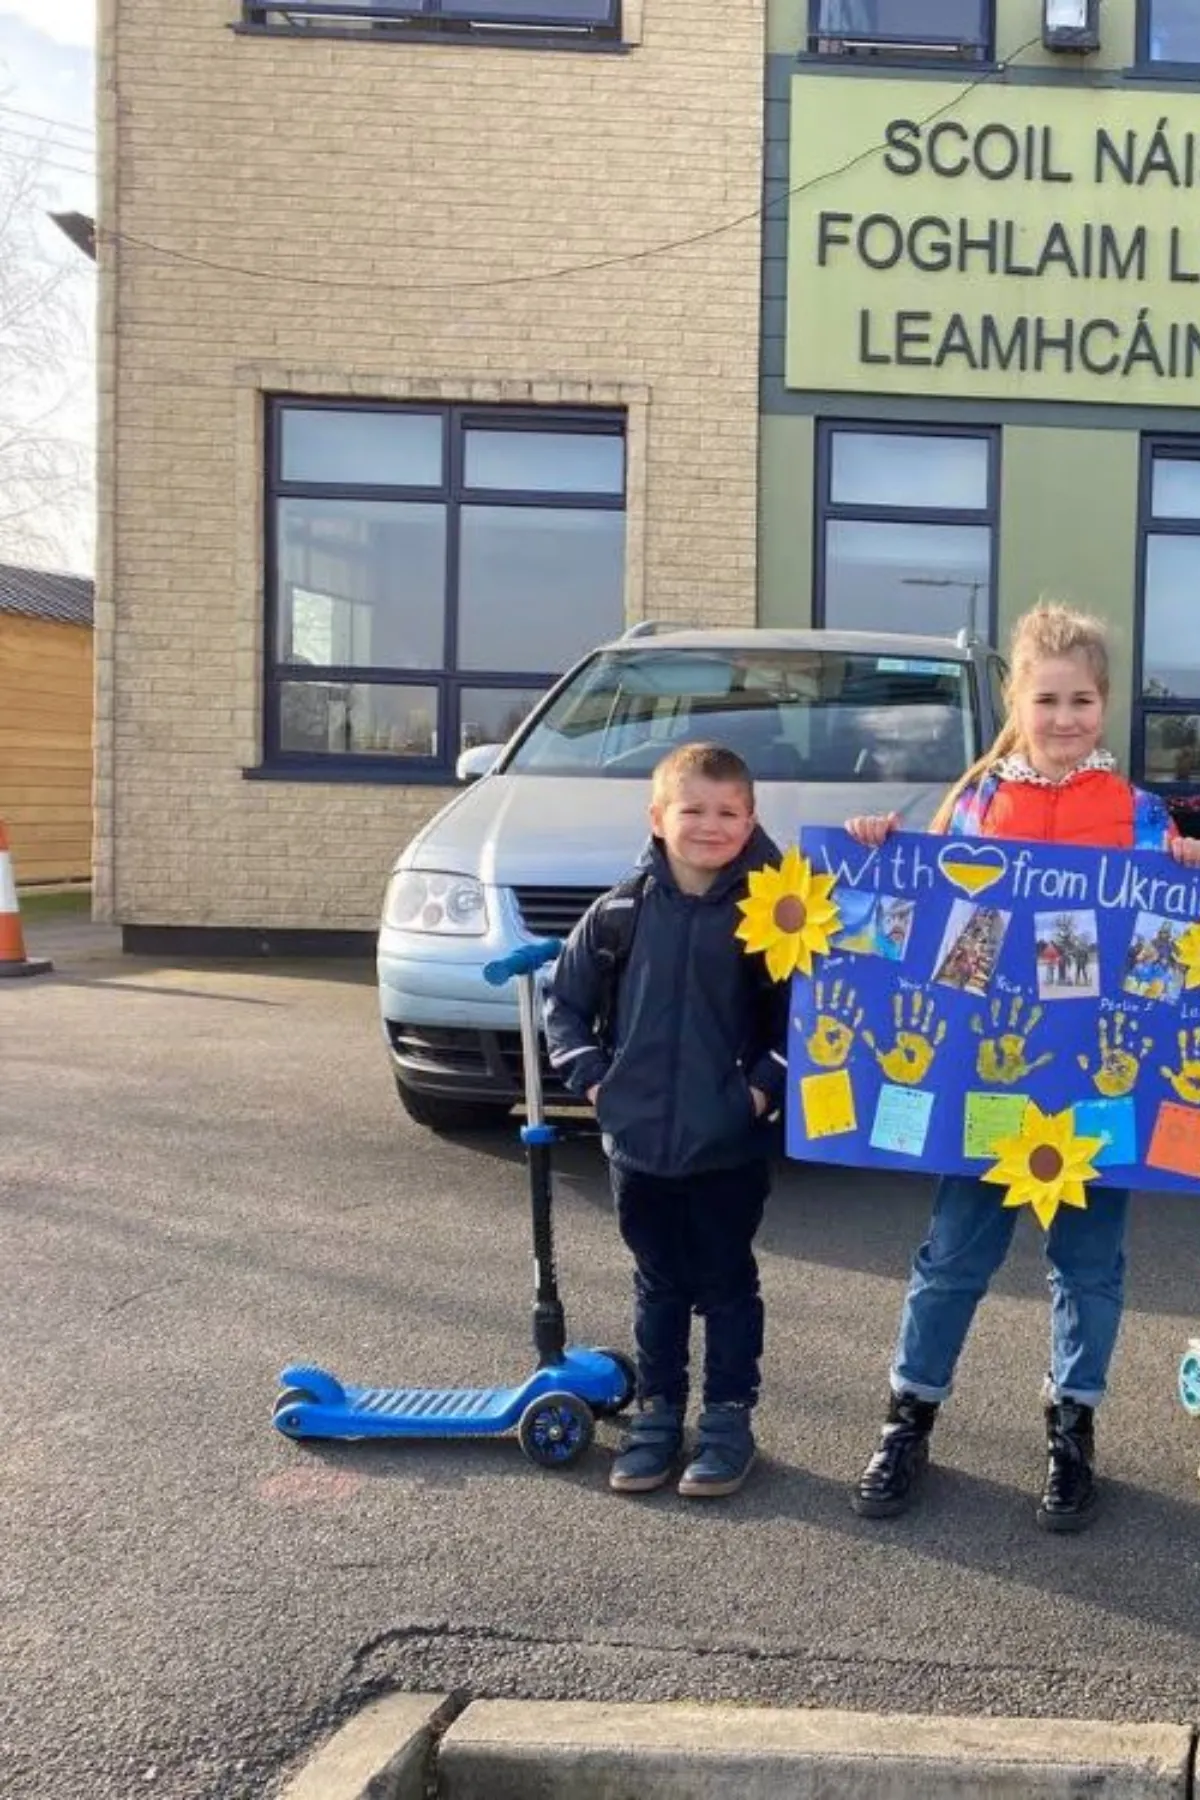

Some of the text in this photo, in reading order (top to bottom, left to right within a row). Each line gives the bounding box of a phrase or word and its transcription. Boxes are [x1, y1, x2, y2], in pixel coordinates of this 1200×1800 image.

[884, 118, 1074, 184] SCOIL
[817, 210, 1147, 282] FOGHLAIM
[820, 845, 935, 890] With
[1011, 850, 1089, 901] from
